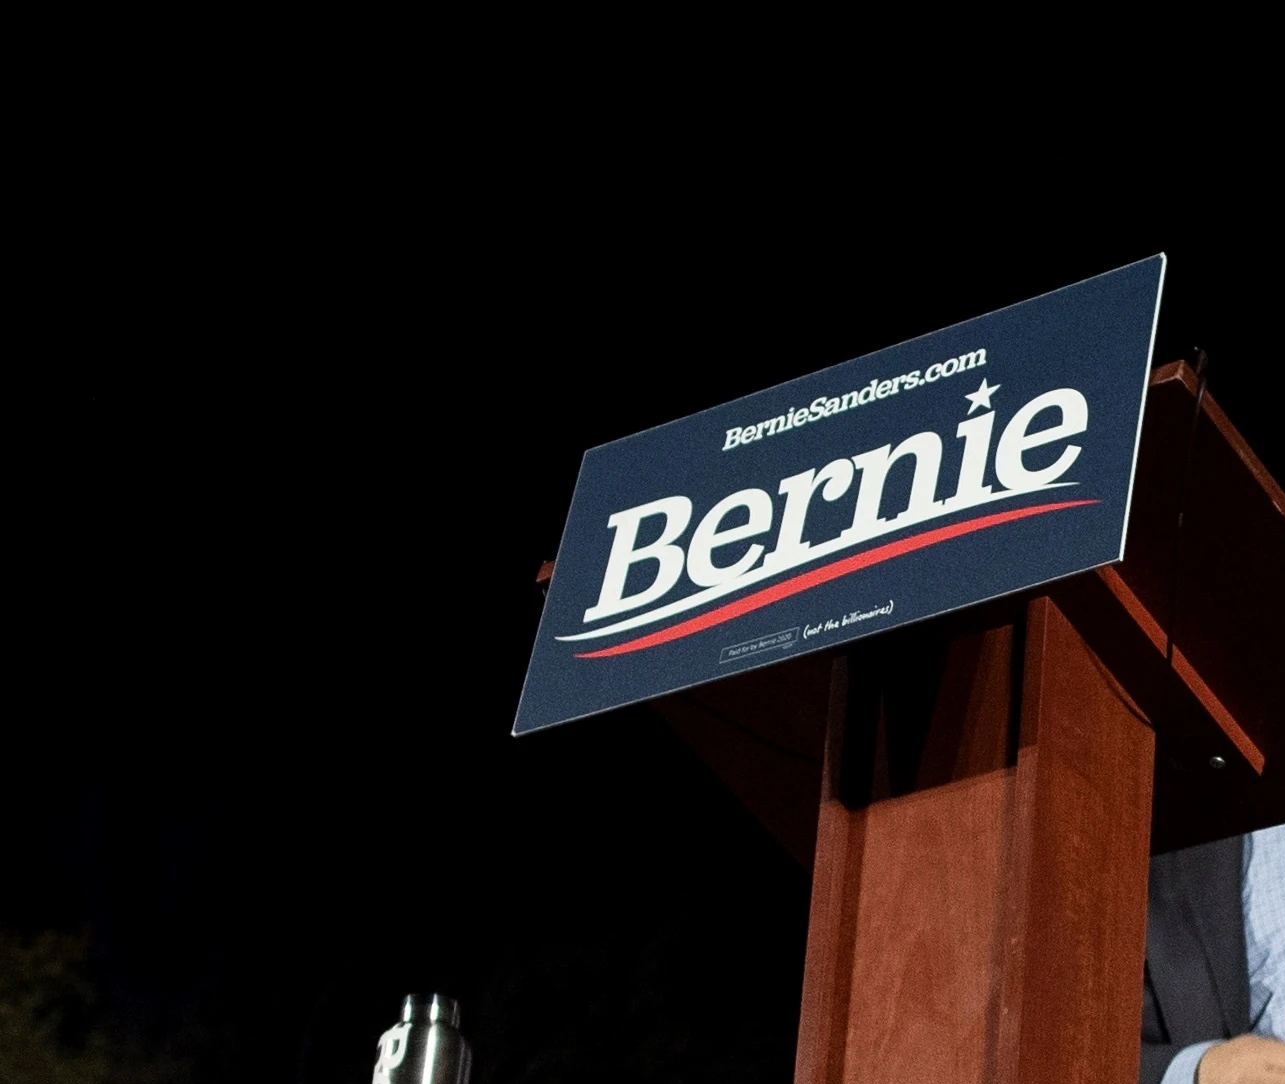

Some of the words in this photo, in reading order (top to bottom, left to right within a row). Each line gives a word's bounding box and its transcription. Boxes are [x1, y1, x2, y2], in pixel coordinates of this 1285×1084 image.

[722, 348, 987, 451] BernieSanders.com
[583, 377, 1090, 623] Bernie
[803, 623, 823, 639] (not
[824, 619, 840, 632] the
[841, 599, 894, 626] billionaires)
